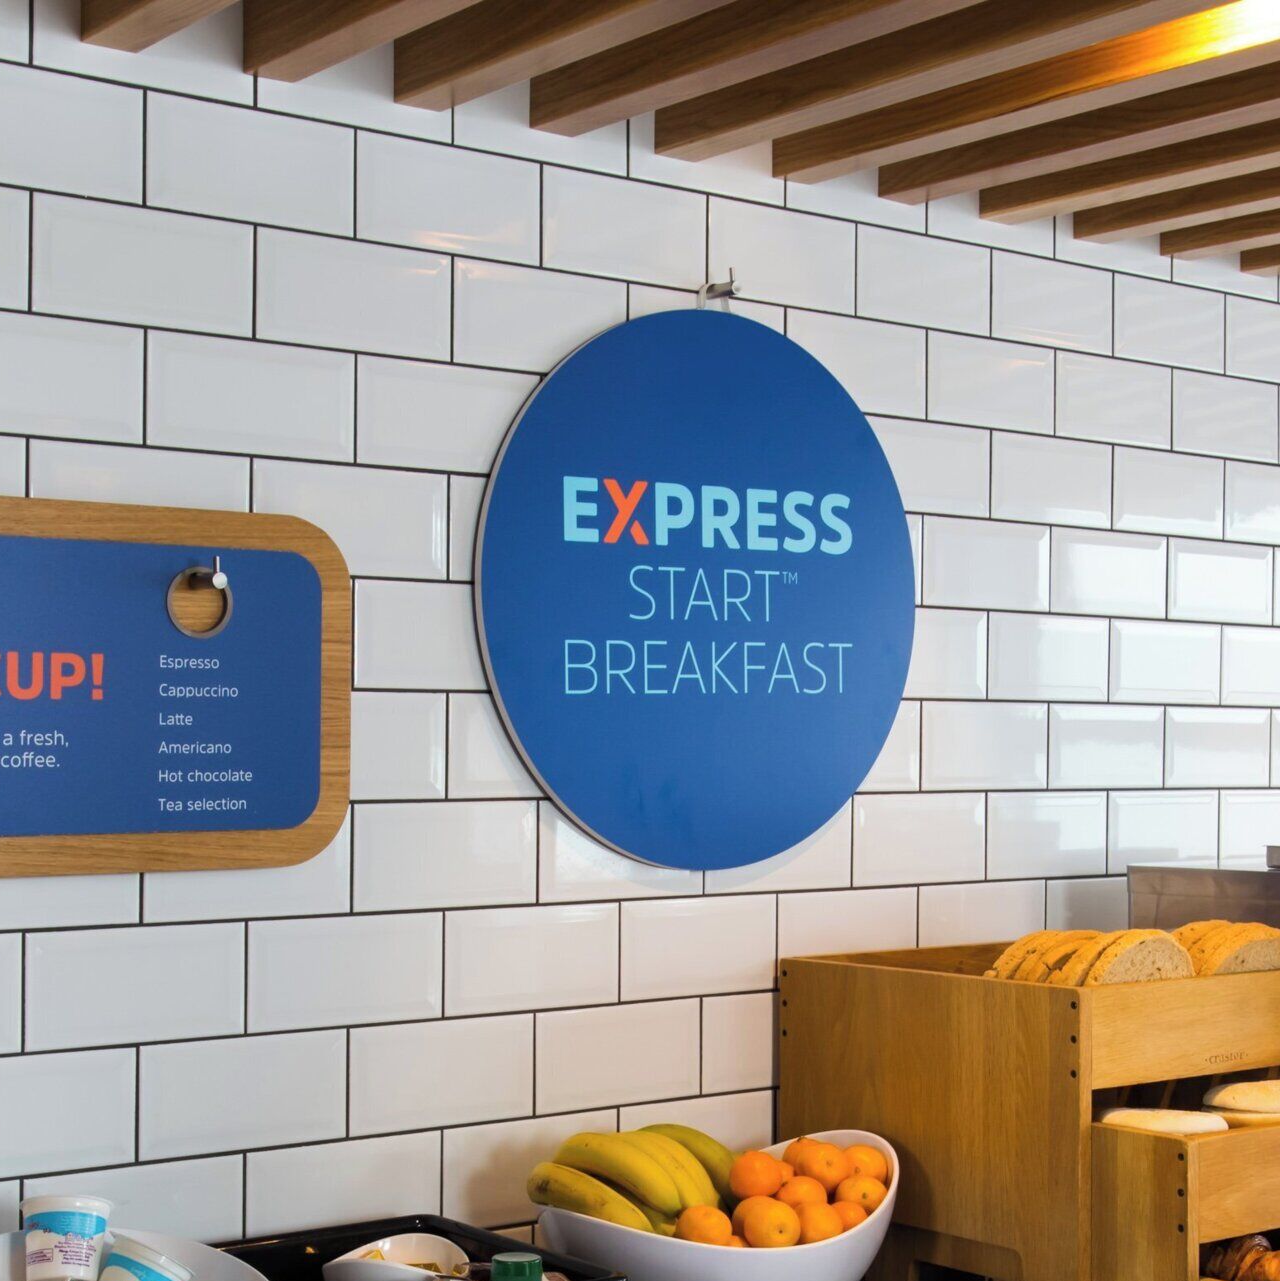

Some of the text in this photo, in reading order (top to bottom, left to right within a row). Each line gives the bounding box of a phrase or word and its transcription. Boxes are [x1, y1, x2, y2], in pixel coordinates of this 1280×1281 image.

[562, 475, 854, 555] EXPRESS
[159, 654, 220, 670] Espresso
[563, 639, 854, 695] BREAKFAST
[159, 683, 239, 699] Cappuccino
[158, 712, 193, 726] Latte
[2, 733, 13, 746] a
[19, 729, 69, 748] fresh,
[158, 740, 232, 754] Americano
[0, 751, 61, 768] coffee.
[158, 769, 253, 783] Hot chocolate
[158, 798, 247, 812] Tea selection
